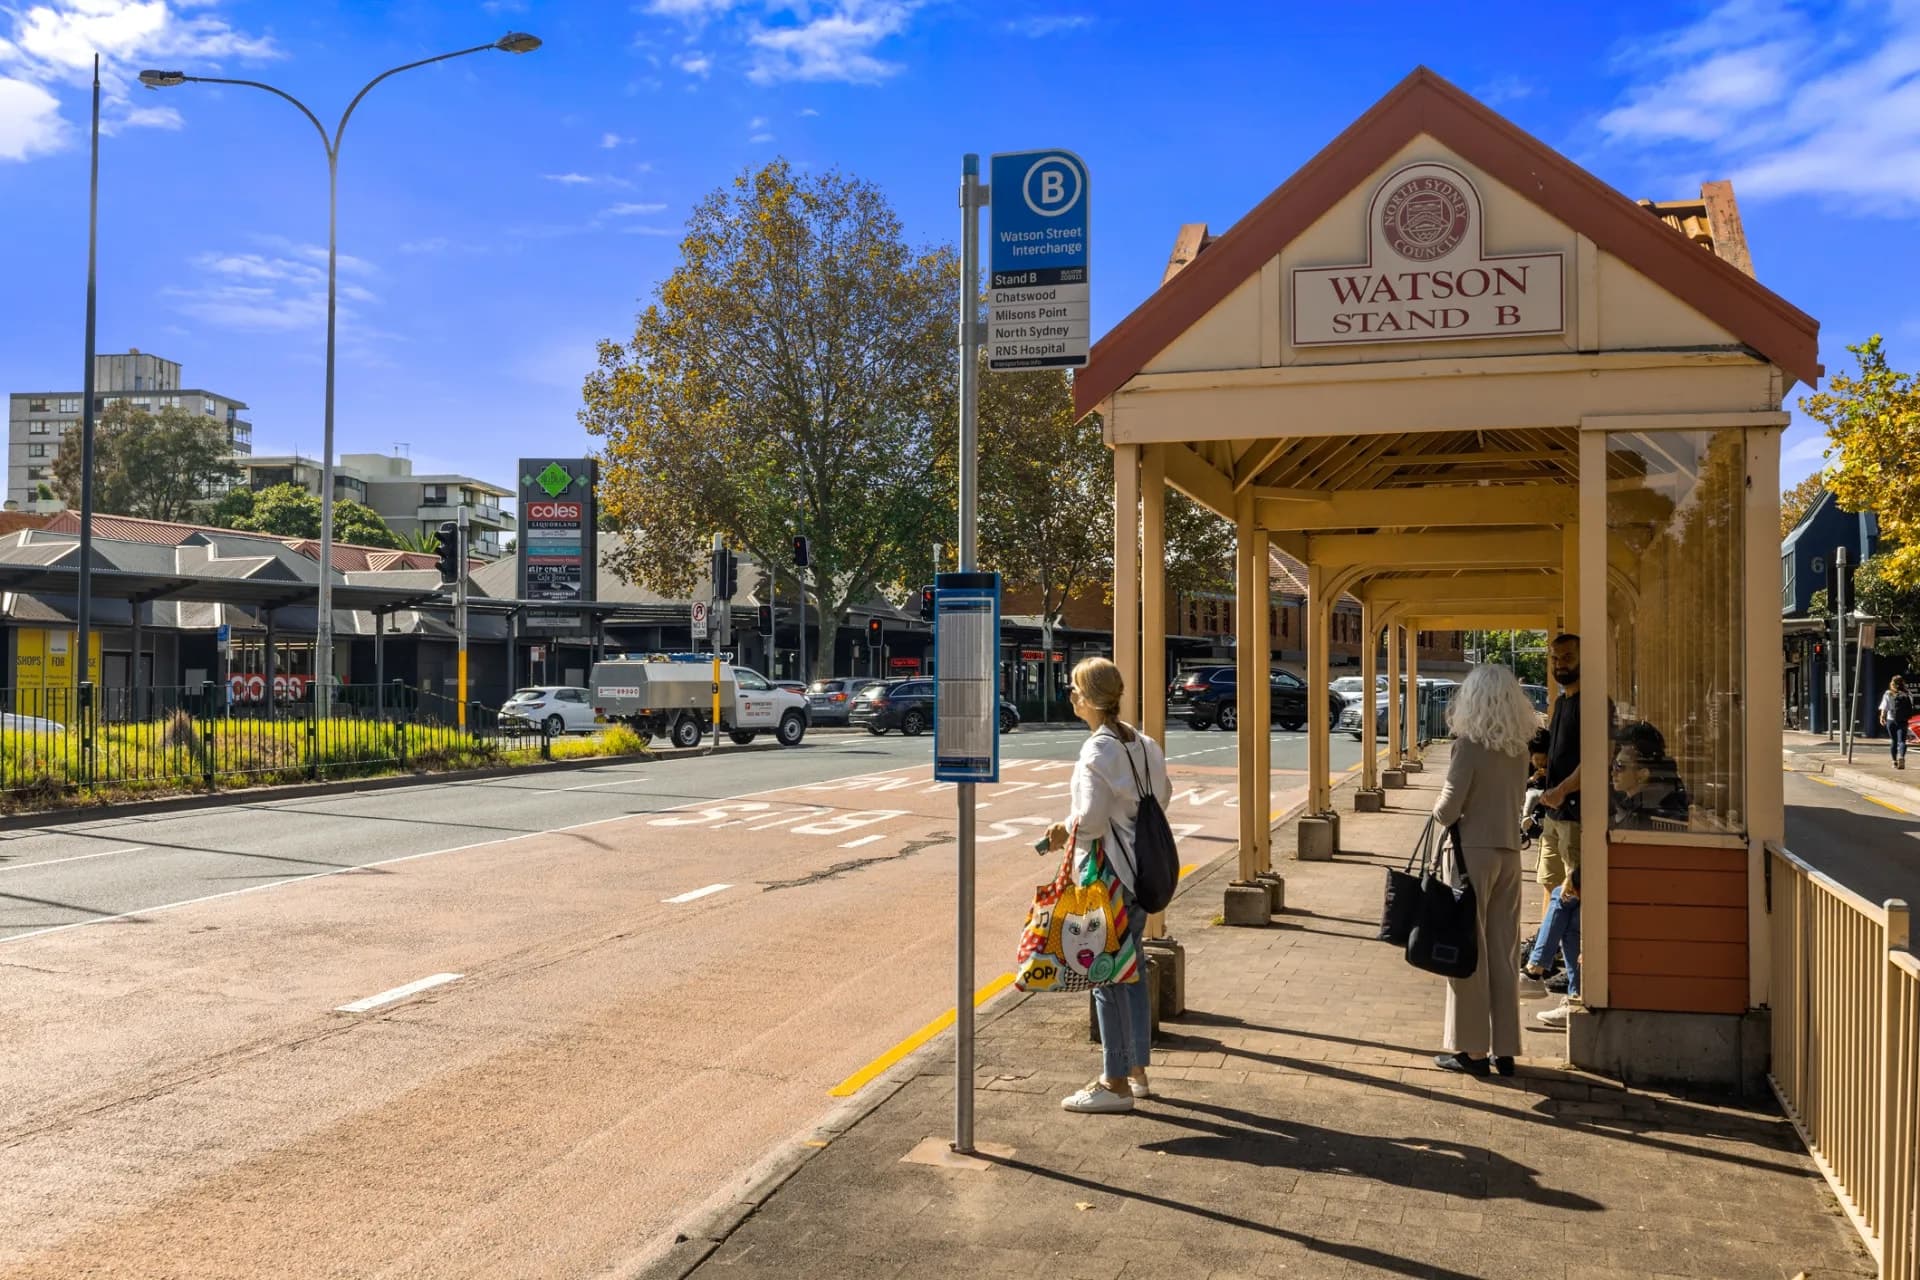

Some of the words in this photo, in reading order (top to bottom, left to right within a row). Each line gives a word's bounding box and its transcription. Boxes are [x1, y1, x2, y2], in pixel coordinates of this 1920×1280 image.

[1041, 170, 1065, 204] B
[1384, 181, 1420, 226] NORTH
[1424, 178, 1467, 220] SYDNEY
[1000, 230, 1043, 243] Watson
[1046, 227, 1082, 239] Street
[1012, 242, 1082, 256] Interchange
[1393, 233, 1460, 258] COUNCIL
[995, 272, 1027, 285] Stand
[1029, 272, 1037, 283] B
[1328, 265, 1531, 305] WATSON
[995, 289, 1056, 303] Chatswood
[995, 309, 1036, 321] Milsons
[1039, 307, 1067, 318] Point
[1332, 308, 1470, 334] STAND
[1495, 305, 1521, 326] B
[995, 327, 1027, 338] North
[1029, 325, 1069, 338] Sydney
[995, 345, 1018, 356] RNS
[1020, 342, 1066, 356] Hospital
[531, 502, 578, 518] coles
[16, 655, 42, 666] SHOPS
[51, 656, 65, 667] FOR
[231, 676, 301, 701] coes
[1023, 965, 1058, 983] POP!
